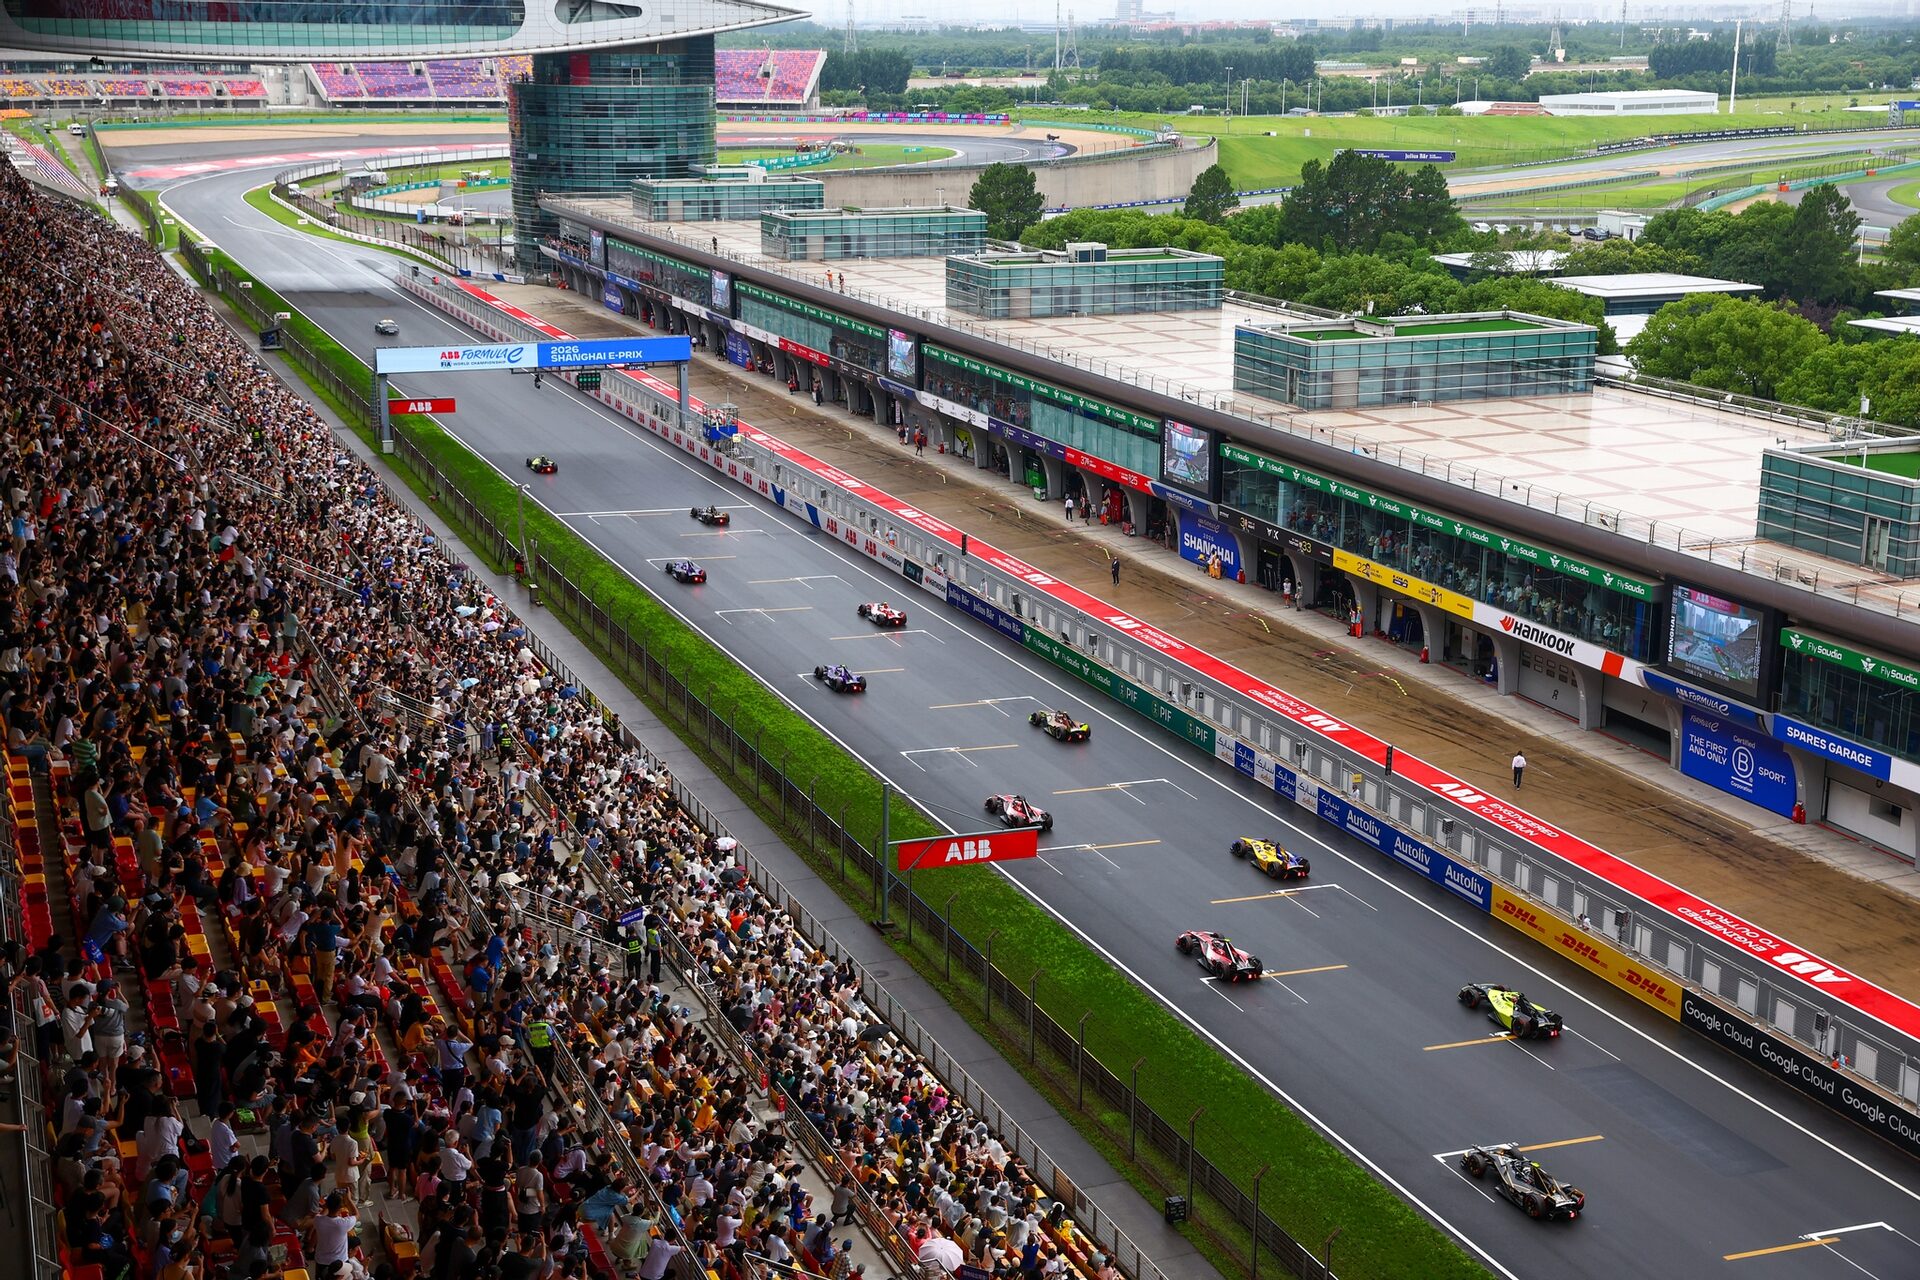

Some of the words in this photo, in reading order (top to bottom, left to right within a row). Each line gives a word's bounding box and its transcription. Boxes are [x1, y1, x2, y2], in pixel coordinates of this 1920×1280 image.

[440, 351, 460, 360] ABB
[461, 348, 507, 361] FORMULA
[551, 345, 579, 355] 2026
[551, 352, 606, 363] SHANGHAI
[608, 350, 643, 361] E-PRIX
[408, 401, 433, 413] ABB
[661, 425, 669, 438] ABB
[674, 432, 682, 445] ABB
[687, 439, 695, 453] ABB
[700, 447, 709, 461] ABB
[714, 454, 723, 469] ABB
[728, 462, 738, 477] ABB
[743, 470, 753, 486] ABB
[758, 479, 768, 495] ABB
[1379, 500, 1400, 513] FlySaudia
[826, 517, 838, 534] ABB
[1421, 513, 1443, 527] FlySaudia
[844, 528, 857, 545] ABB
[1466, 529, 1489, 543] FlySaudia
[864, 538, 877, 557] ABB
[1513, 544, 1538, 560] FlySaudia
[1563, 561, 1590, 577] FlySaudia
[1616, 579, 1645, 596] FlySaudia
[1667, 615, 1676, 662] SHANGHAI
[1807, 641, 1843, 661] FlySaudia
[1880, 665, 1918, 686] FlySaudia
[1126, 687, 1138, 703] PIF
[1551, 689, 1559, 700] 8
[1675, 687, 1689, 698] ABB
[1688, 691, 1721, 710] FORMULA
[1159, 706, 1172, 723] PIF
[1641, 700, 1648, 713] 7
[1195, 725, 1208, 743] PIF
[1733, 734, 1756, 749] Certified
[1689, 733, 1705, 745] THE
[1706, 740, 1728, 756] FIRST
[1787, 726, 1827, 750] SPARES
[1828, 742, 1872, 767] GARAGE
[1689, 744, 1706, 757] AND
[1707, 750, 1727, 766] ONLY
[1738, 752, 1749, 772] B
[1758, 766, 1787, 785] SPORT.
[1430, 783, 1487, 804] ABB
[1730, 780, 1753, 793] Corporation
[1324, 808, 1339, 821] sabic
[1477, 805, 1493, 814] TO
[1492, 814, 1539, 837] OUTRUN
[1489, 803, 1559, 838] ENGINEERED
[1347, 809, 1381, 838] Autoliv
[945, 839, 992, 862] ABB
[1394, 836, 1431, 866] Autoliv
[1445, 864, 1484, 896] Autoliv
[1502, 899, 1540, 929] DHL
[1677, 907, 1768, 953] ENGINEERED
[1701, 909, 1756, 938] OUTRUN
[1560, 933, 1603, 964] DHL
[1759, 937, 1781, 949] TO
[1772, 952, 1852, 983] ABB
[1625, 968, 1670, 1003] DHL
[1684, 1000, 1722, 1031] Google
[1723, 1022, 1754, 1050] Cloud
[1760, 1042, 1800, 1076] Google
[1801, 1067, 1835, 1095] Cloud
[1842, 1087, 1886, 1124] Google
